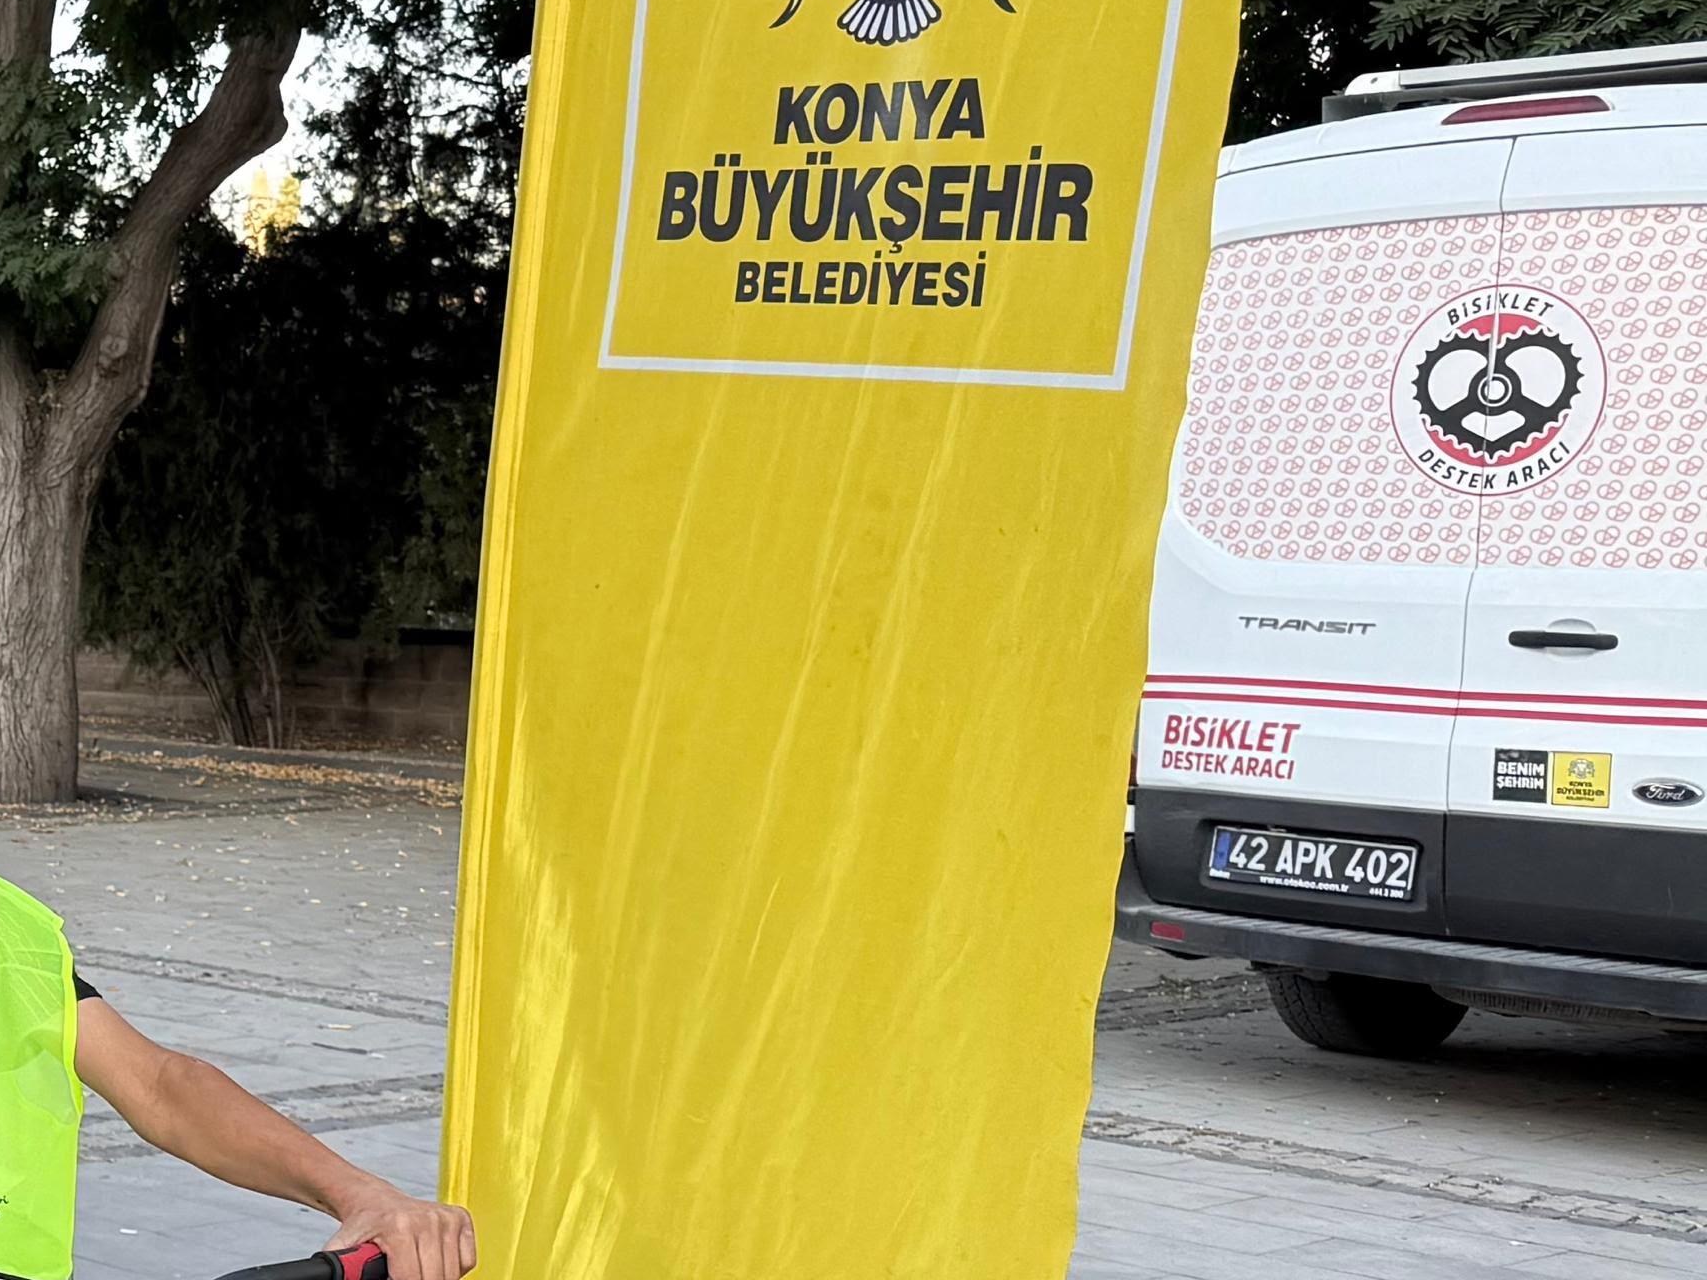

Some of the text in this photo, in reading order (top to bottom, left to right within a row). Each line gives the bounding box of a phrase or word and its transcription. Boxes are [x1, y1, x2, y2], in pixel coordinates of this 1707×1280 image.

[774, 78, 985, 144] KONYA
[657, 145, 1093, 253] BÜYÜKŞEHİR
[734, 251, 987, 307] BELEDİYESİ
[1447, 292, 1554, 326] BİSİKLET
[1418, 441, 1570, 489] DESTEK ARACI
[1238, 616, 1377, 636] TRANSIT
[1163, 714, 1301, 754] BİSİKLET
[1161, 750, 1295, 780] DESTEK ARACI
[1496, 775, 1544, 790] ŞEHRİM
[1645, 784, 1686, 801] Ford
[1229, 834, 1411, 888] 42 APK 402
